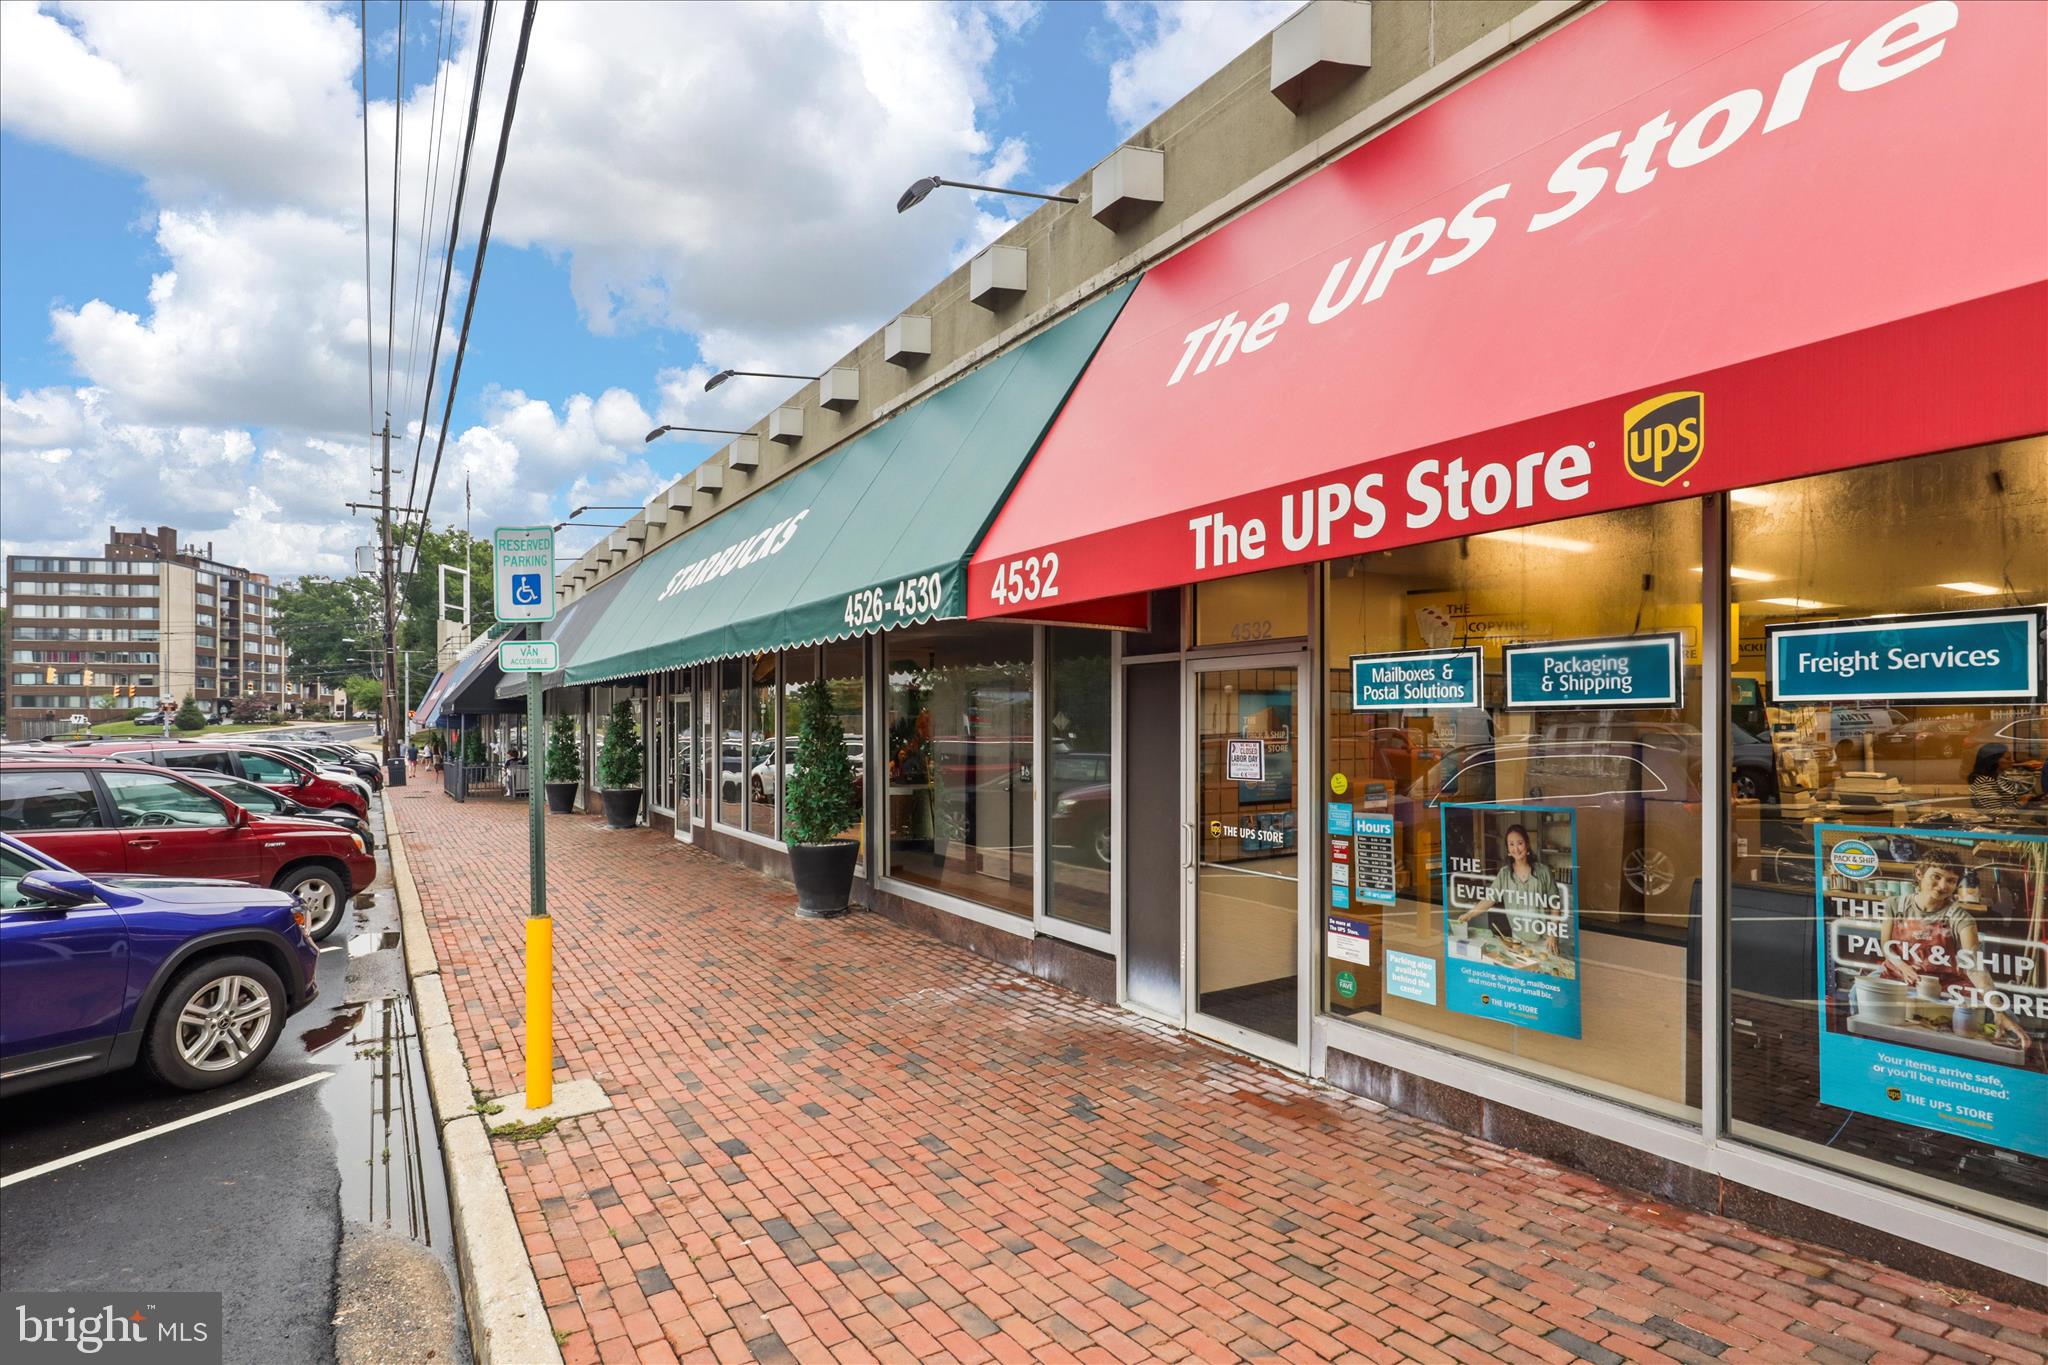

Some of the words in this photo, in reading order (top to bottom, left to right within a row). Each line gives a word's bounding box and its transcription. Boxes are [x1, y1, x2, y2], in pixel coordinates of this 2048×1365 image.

[1167, 303, 1289, 386] The
[1308, 183, 1510, 325] UPS
[1527, 0, 1960, 232] Store
[1630, 417, 1698, 473] ups
[1189, 512, 1266, 570] The
[1281, 473, 1386, 551] UPS
[499, 538, 550, 551] RESERVED
[658, 508, 810, 601] STARBUCKS
[503, 554, 547, 567] PARKING
[990, 552, 1059, 605] 4532
[844, 572, 942, 627] 4526-4530
[1446, 603, 1471, 614] THE
[1231, 620, 1272, 640] 4532
[510, 657, 548, 665] ACCESSIBLE
[520, 648, 538, 657] VAN
[1799, 650, 1879, 678] Freight
[1887, 645, 2000, 670] Services
[1372, 666, 1435, 683] Mailboxes
[1442, 663, 1454, 680] &
[1544, 654, 1629, 676] Packaging
[1363, 684, 1399, 700] Postal
[1404, 682, 1465, 699] Solutions
[1541, 675, 1554, 692] &
[1559, 673, 1633, 695] Shipping
[1231, 754, 1247, 763] LABOR
[1248, 755, 1258, 763] DAY
[1268, 744, 1289, 753] STORE
[1223, 826, 1238, 837] THE
[1240, 828, 1256, 839] UPS
[1257, 830, 1284, 843] STORE
[1357, 820, 1391, 834] Hours
[1450, 857, 1481, 873] THE
[1457, 884, 1561, 910] EVERYTHING
[1831, 897, 1886, 919] THE
[1513, 917, 1569, 939] STORE
[1390, 954, 1416, 968] Parking
[1417, 960, 1433, 970] also
[1848, 935, 1923, 962] PACK
[1928, 945, 1951, 966] &
[1956, 950, 2035, 977] SHIP
[1392, 973, 1417, 985] behind
[1418, 979, 1430, 989] the
[1395, 966, 1427, 978] available
[1461, 967, 1472, 975] Get
[1472, 970, 1497, 981] packing,
[1527, 980, 1560, 992] mailboxes
[1400, 985, 1423, 995] center
[1468, 977, 1480, 985] and
[1480, 980, 1497, 988] more
[1497, 982, 1506, 990] for
[1507, 985, 1522, 993] your
[1523, 988, 1541, 997] small
[1491, 998, 1502, 1007] THE
[1504, 1001, 1517, 1010] UPS
[1518, 1004, 1538, 1014] STORE
[1947, 984, 2048, 1019] STORE
[1873, 1064, 1885, 1073] or
[1887, 1066, 1917, 1079] you'll
[1920, 1073, 1934, 1083] be
[1878, 1052, 1902, 1065] Your
[1905, 1058, 1937, 1072] items
[1939, 1067, 1973, 1080] arrive
[1975, 1074, 2004, 1088] safe,
[1905, 1093, 1926, 1106] THE
[1929, 1099, 1952, 1112] UPS
[1956, 1105, 1994, 1122] STORE
